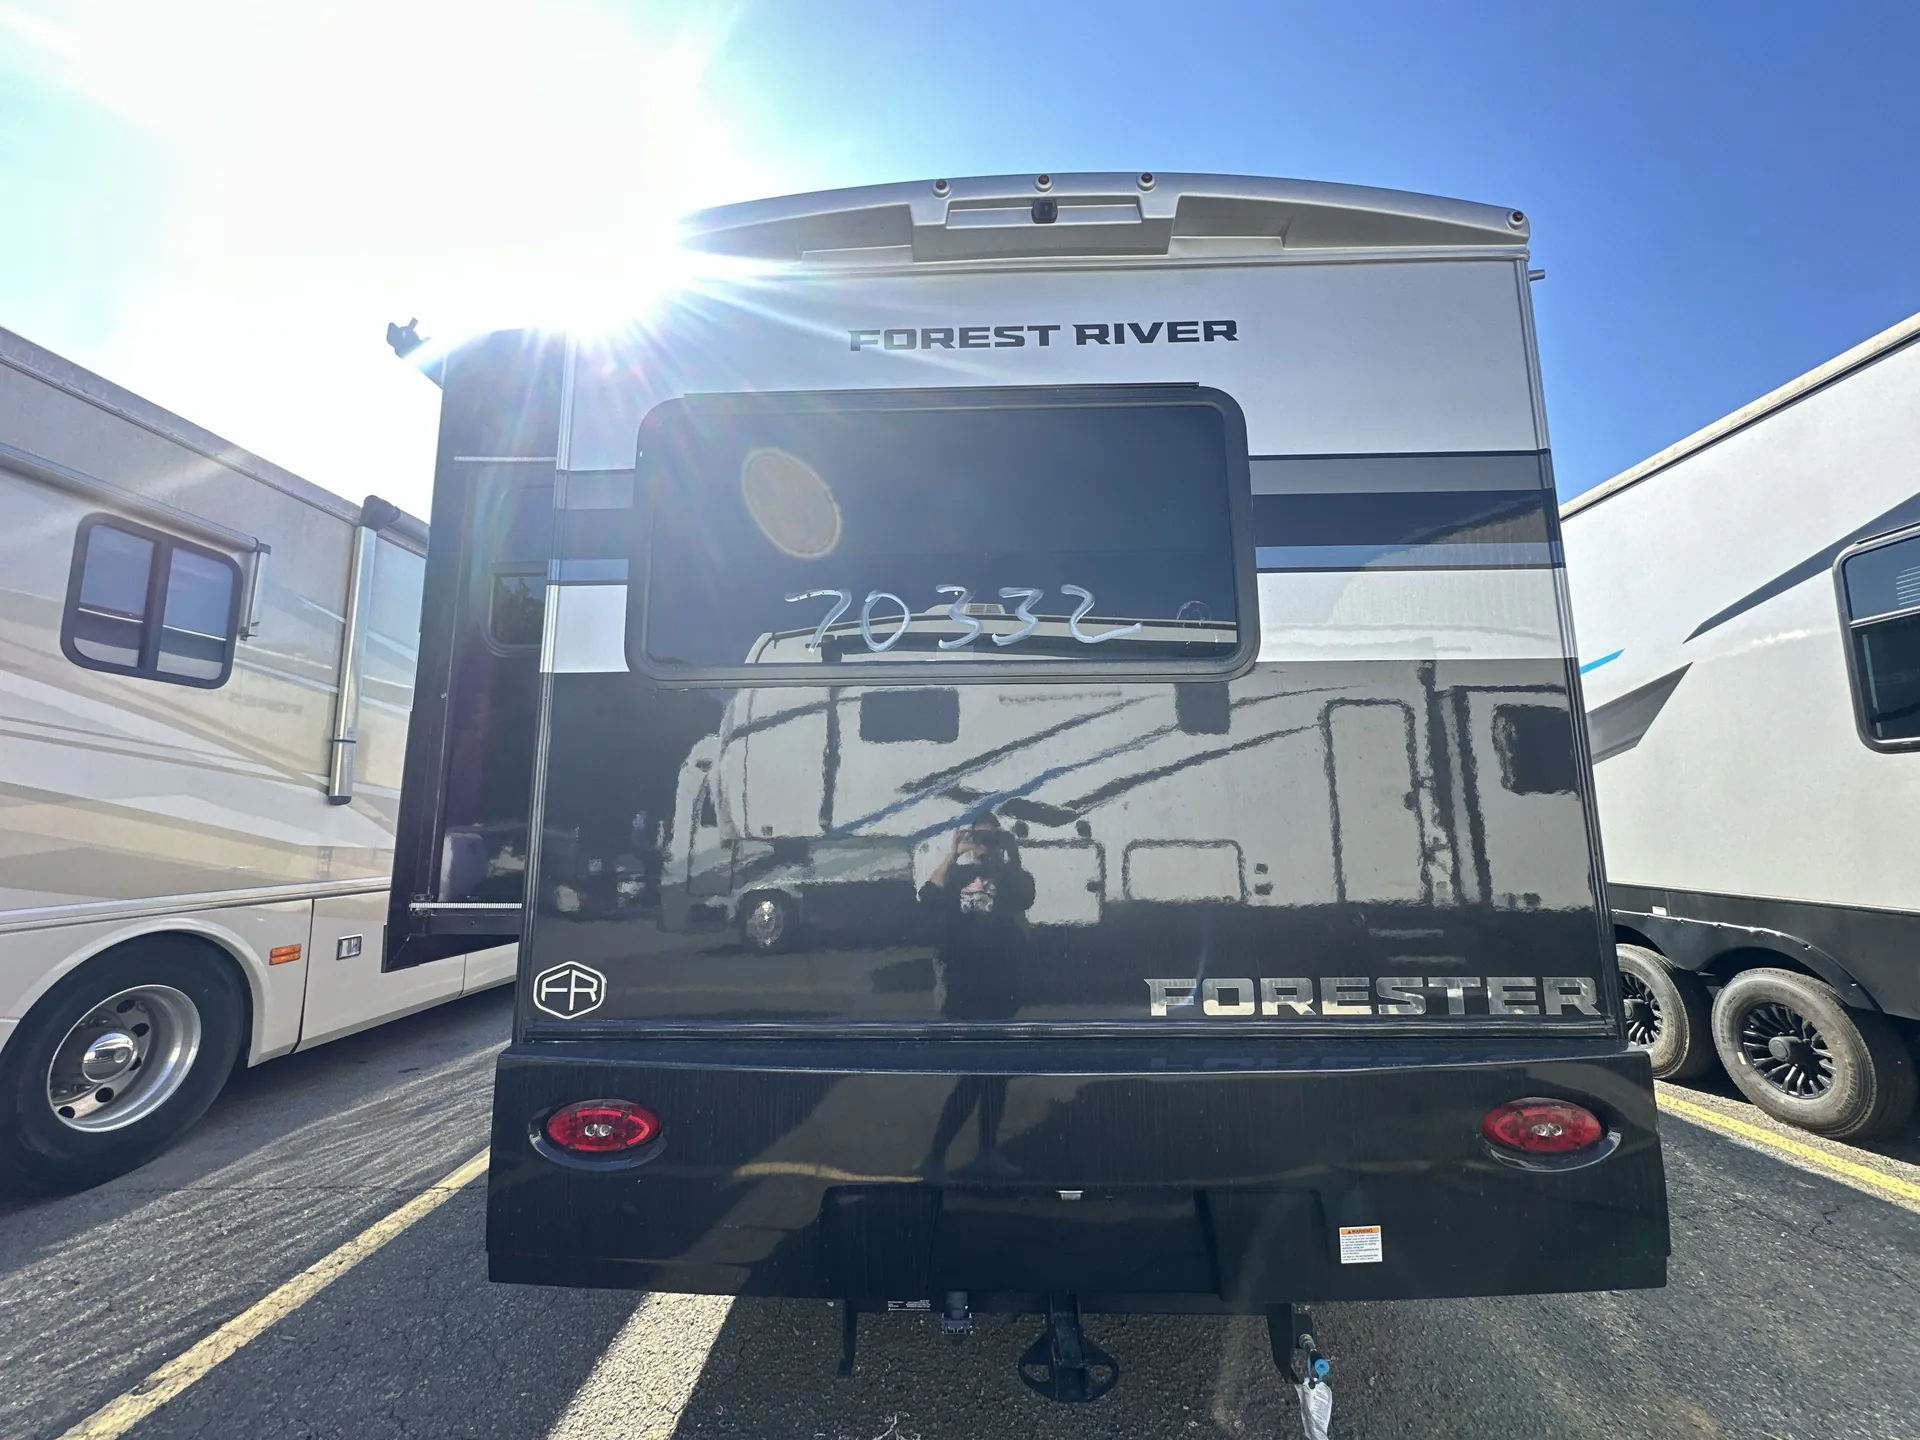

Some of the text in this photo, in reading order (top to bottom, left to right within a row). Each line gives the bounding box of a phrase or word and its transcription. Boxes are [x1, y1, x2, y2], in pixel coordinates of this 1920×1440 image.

[847, 319, 1240, 352] FOREST RIVER
[784, 583, 1144, 653] 70332
[1144, 976, 1602, 1017] FORESTER
